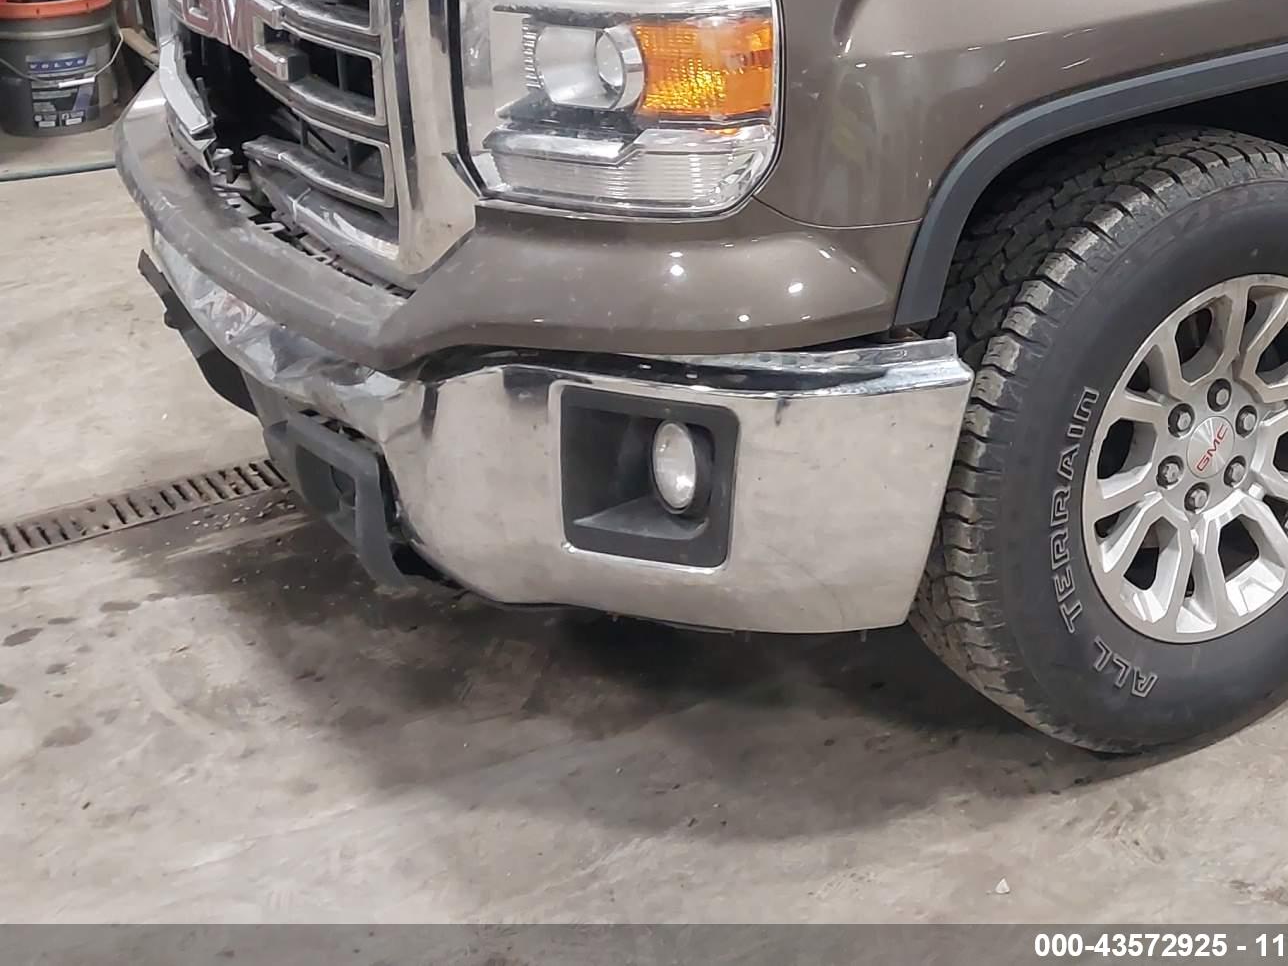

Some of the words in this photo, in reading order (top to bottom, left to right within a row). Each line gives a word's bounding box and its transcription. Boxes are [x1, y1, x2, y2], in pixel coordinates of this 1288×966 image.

[1196, 423, 1229, 472] GMC
[1050, 386, 1100, 634] TERRAIN
[1093, 635, 1158, 698] ALL
